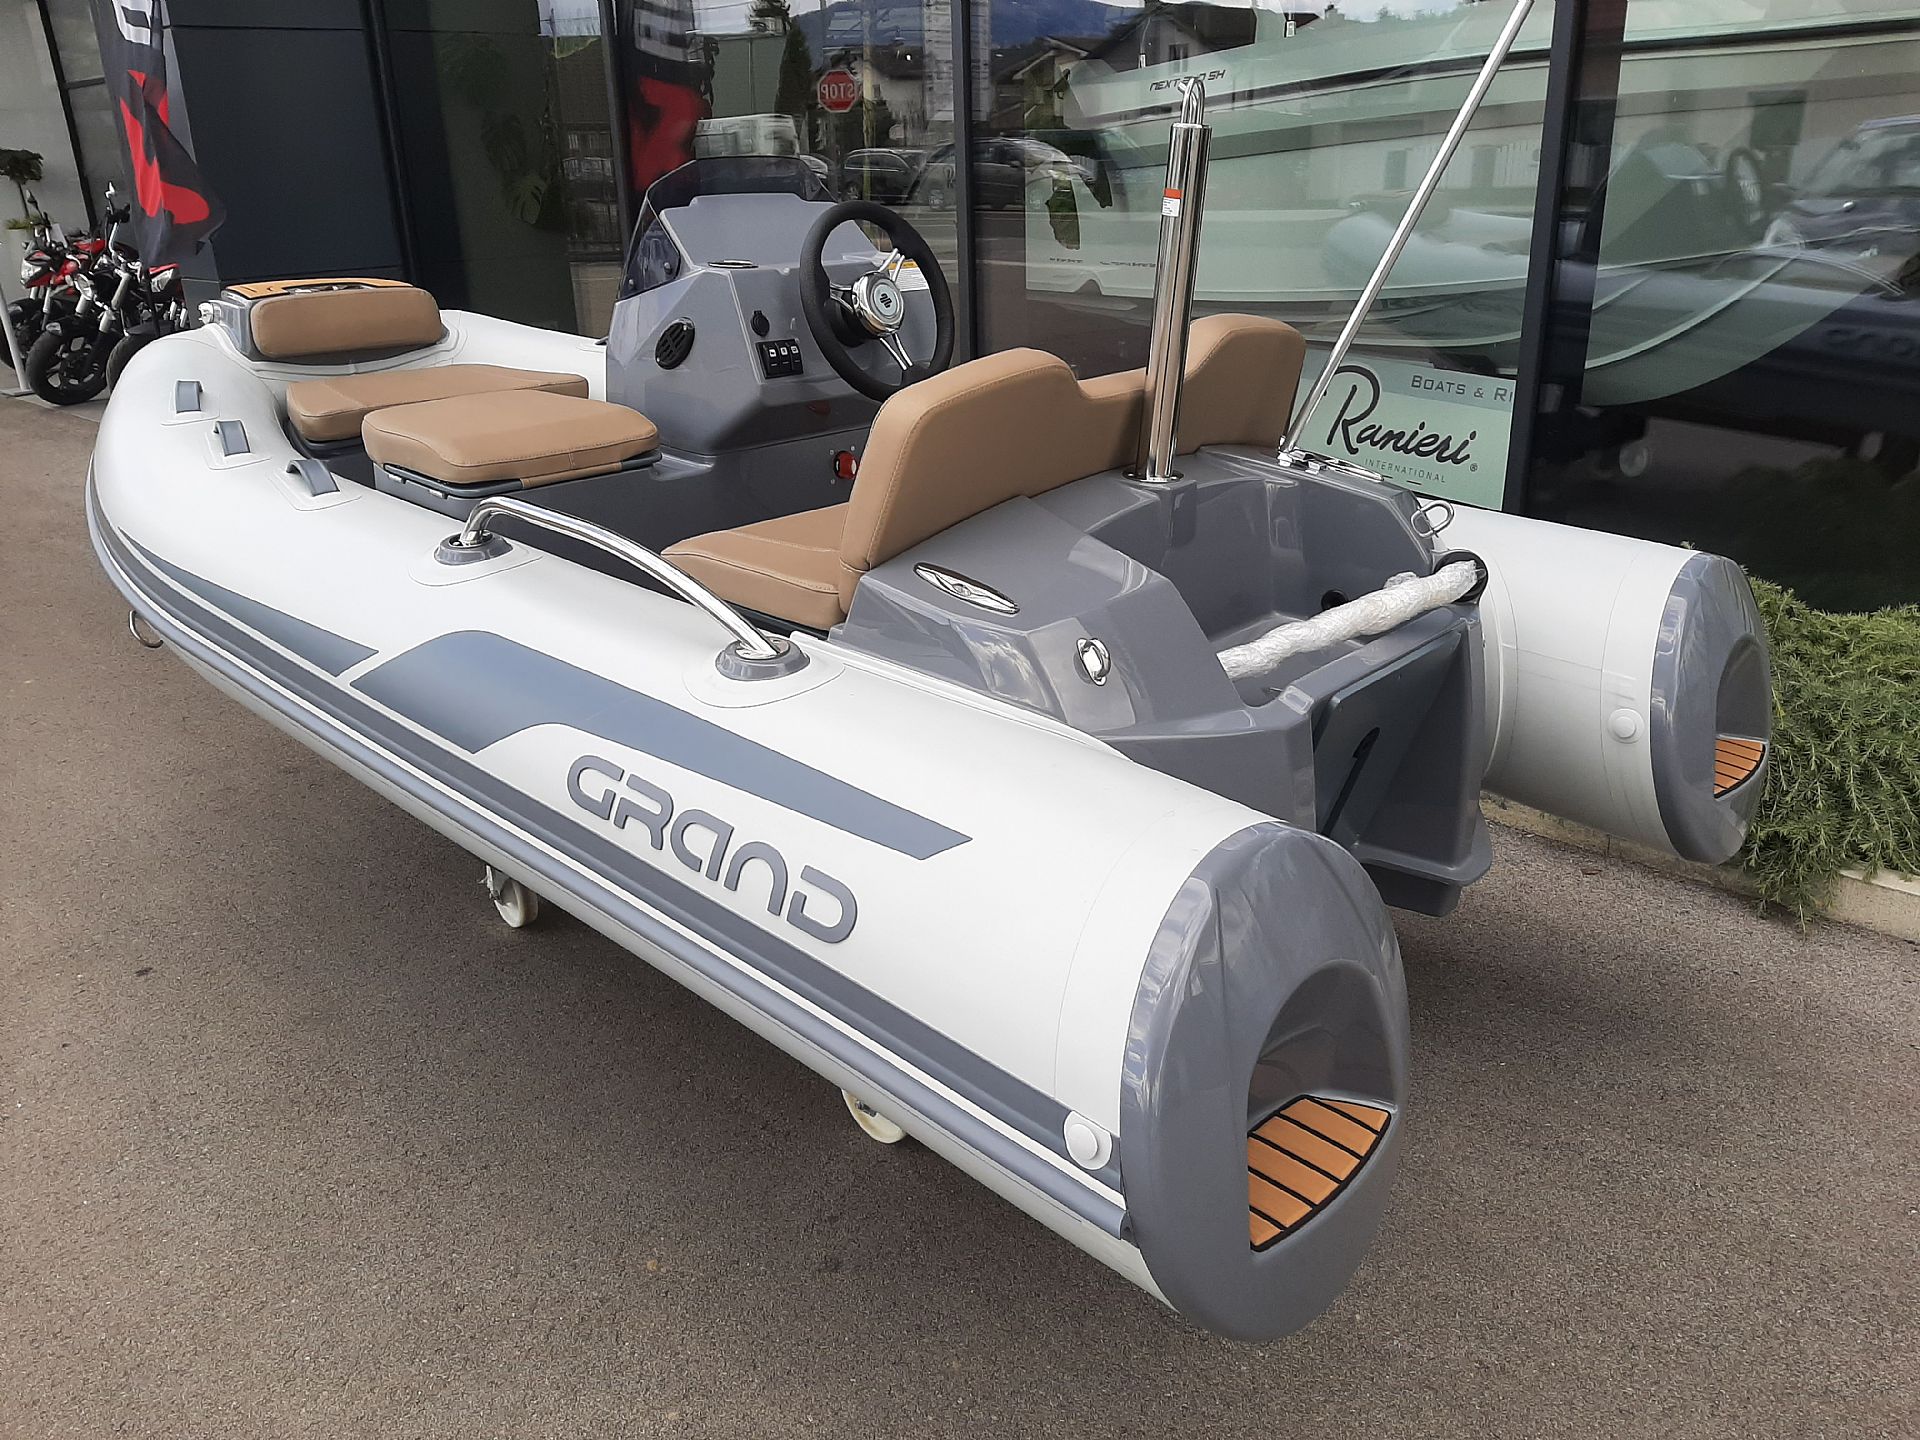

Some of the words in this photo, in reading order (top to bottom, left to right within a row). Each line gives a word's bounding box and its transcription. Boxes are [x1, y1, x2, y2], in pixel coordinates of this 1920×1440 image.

[1323, 364, 1477, 465] Ranieri
[1411, 375, 1466, 395] BOATS
[1473, 387, 1484, 398] &
[1364, 458, 1446, 483] INTERNATIONAL
[566, 754, 858, 944] GRAND
